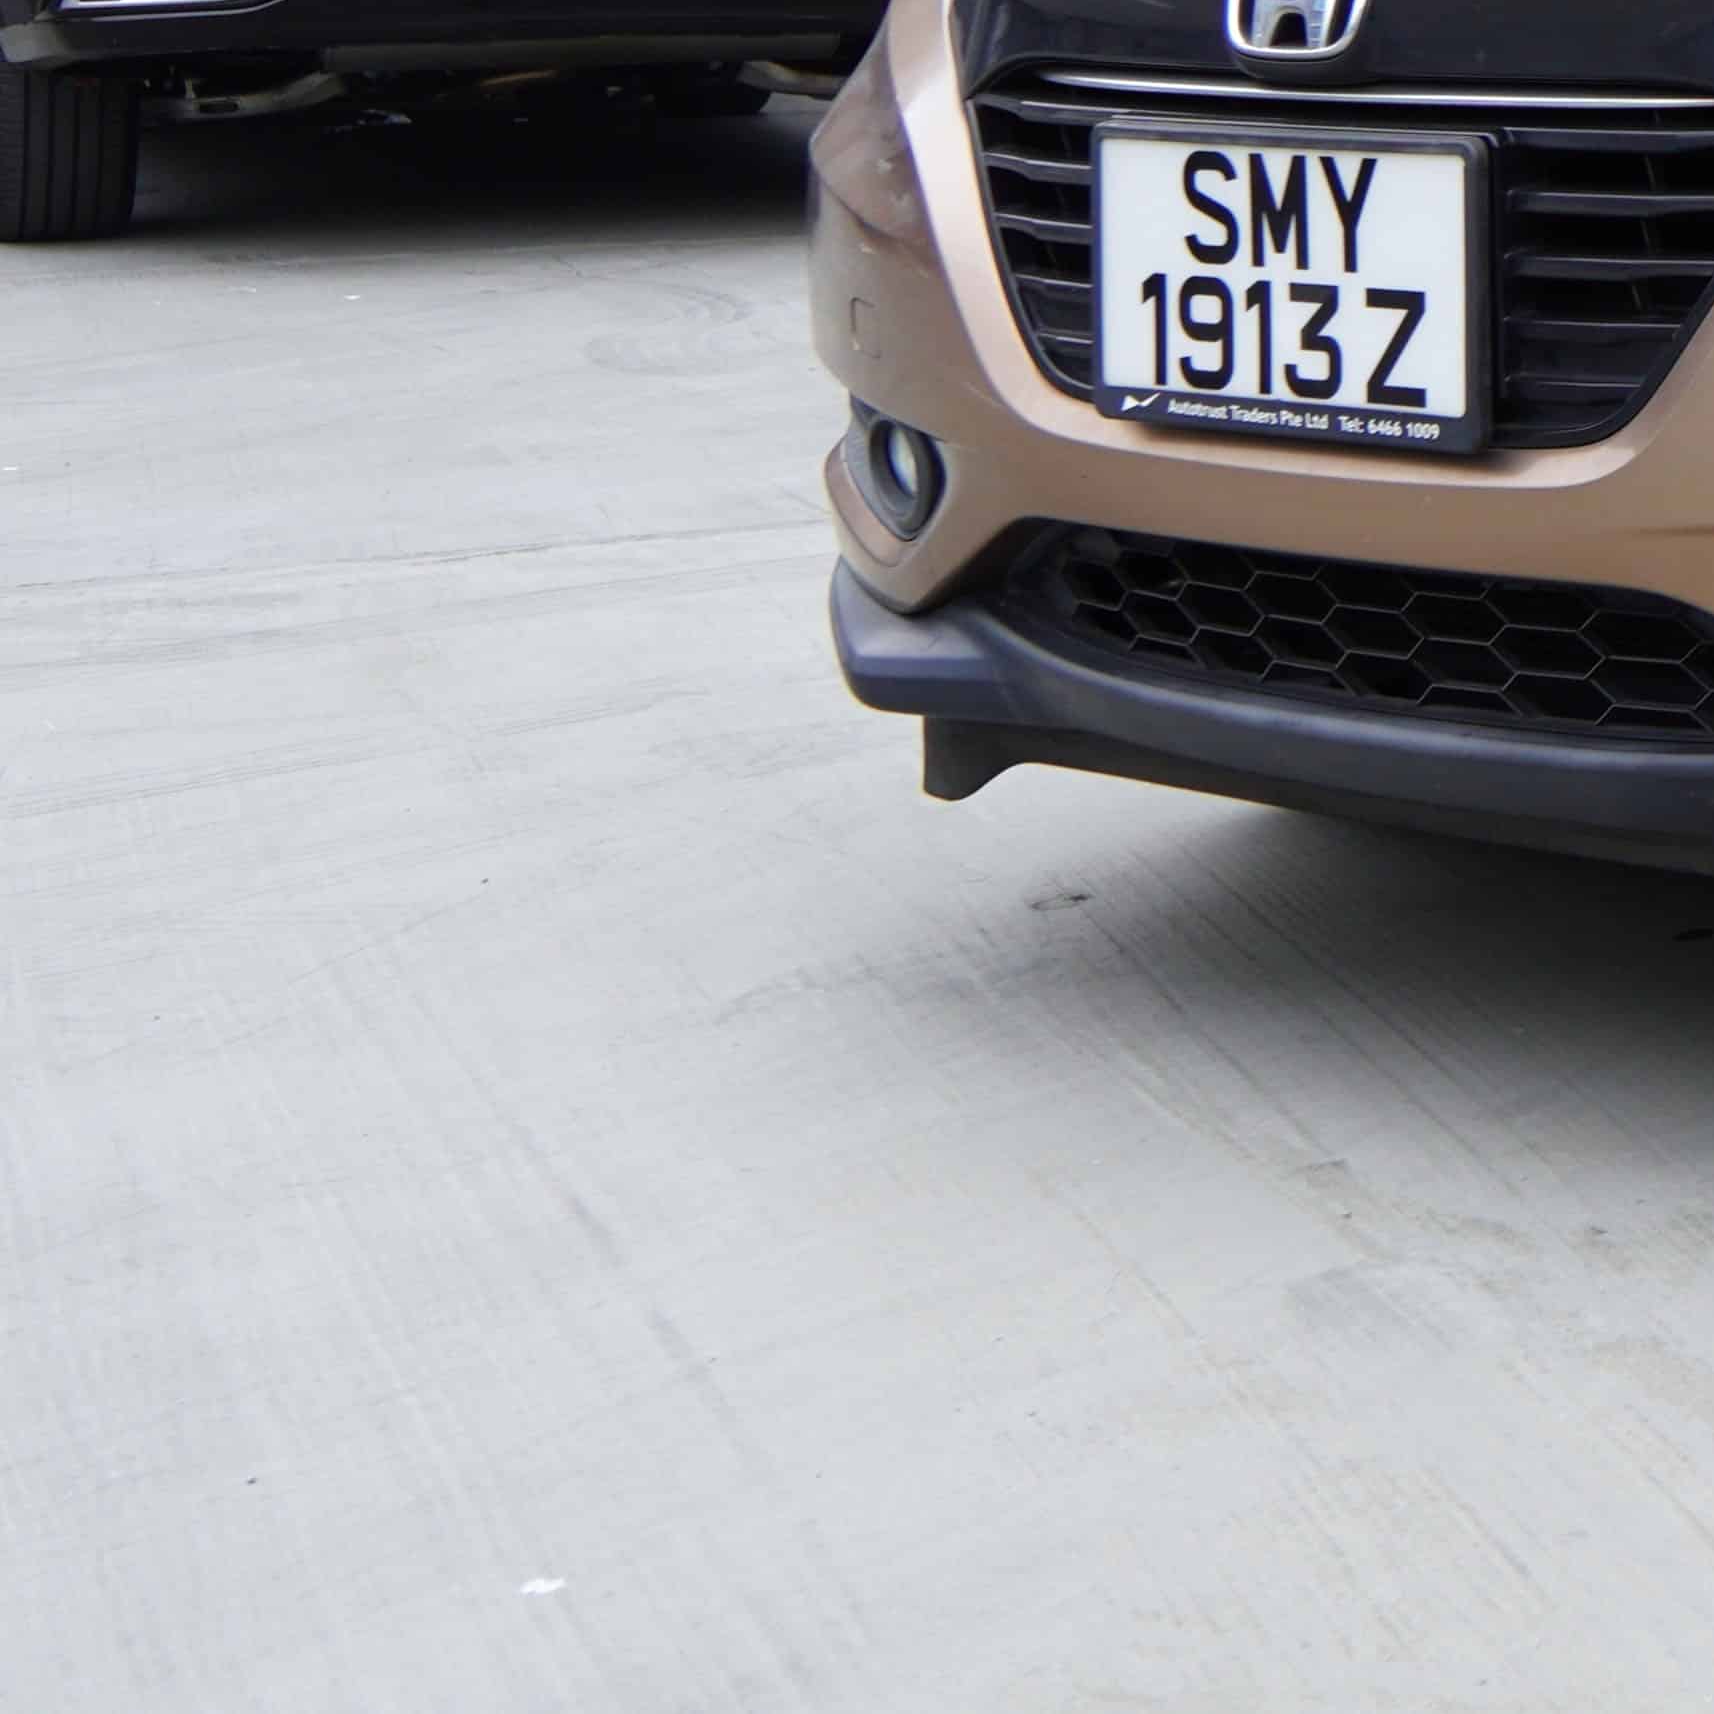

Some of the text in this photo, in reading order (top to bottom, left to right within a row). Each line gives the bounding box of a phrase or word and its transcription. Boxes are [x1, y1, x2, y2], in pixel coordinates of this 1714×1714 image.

[1183, 150, 1377, 273] SMY
[1141, 273, 1427, 408] 1913Z
[1168, 397, 1228, 420] Autotrust
[1229, 405, 1278, 425] Traders
[1279, 410, 1303, 427] Pte
[1305, 413, 1328, 429] Ltd
[1338, 415, 1364, 433] Tel:
